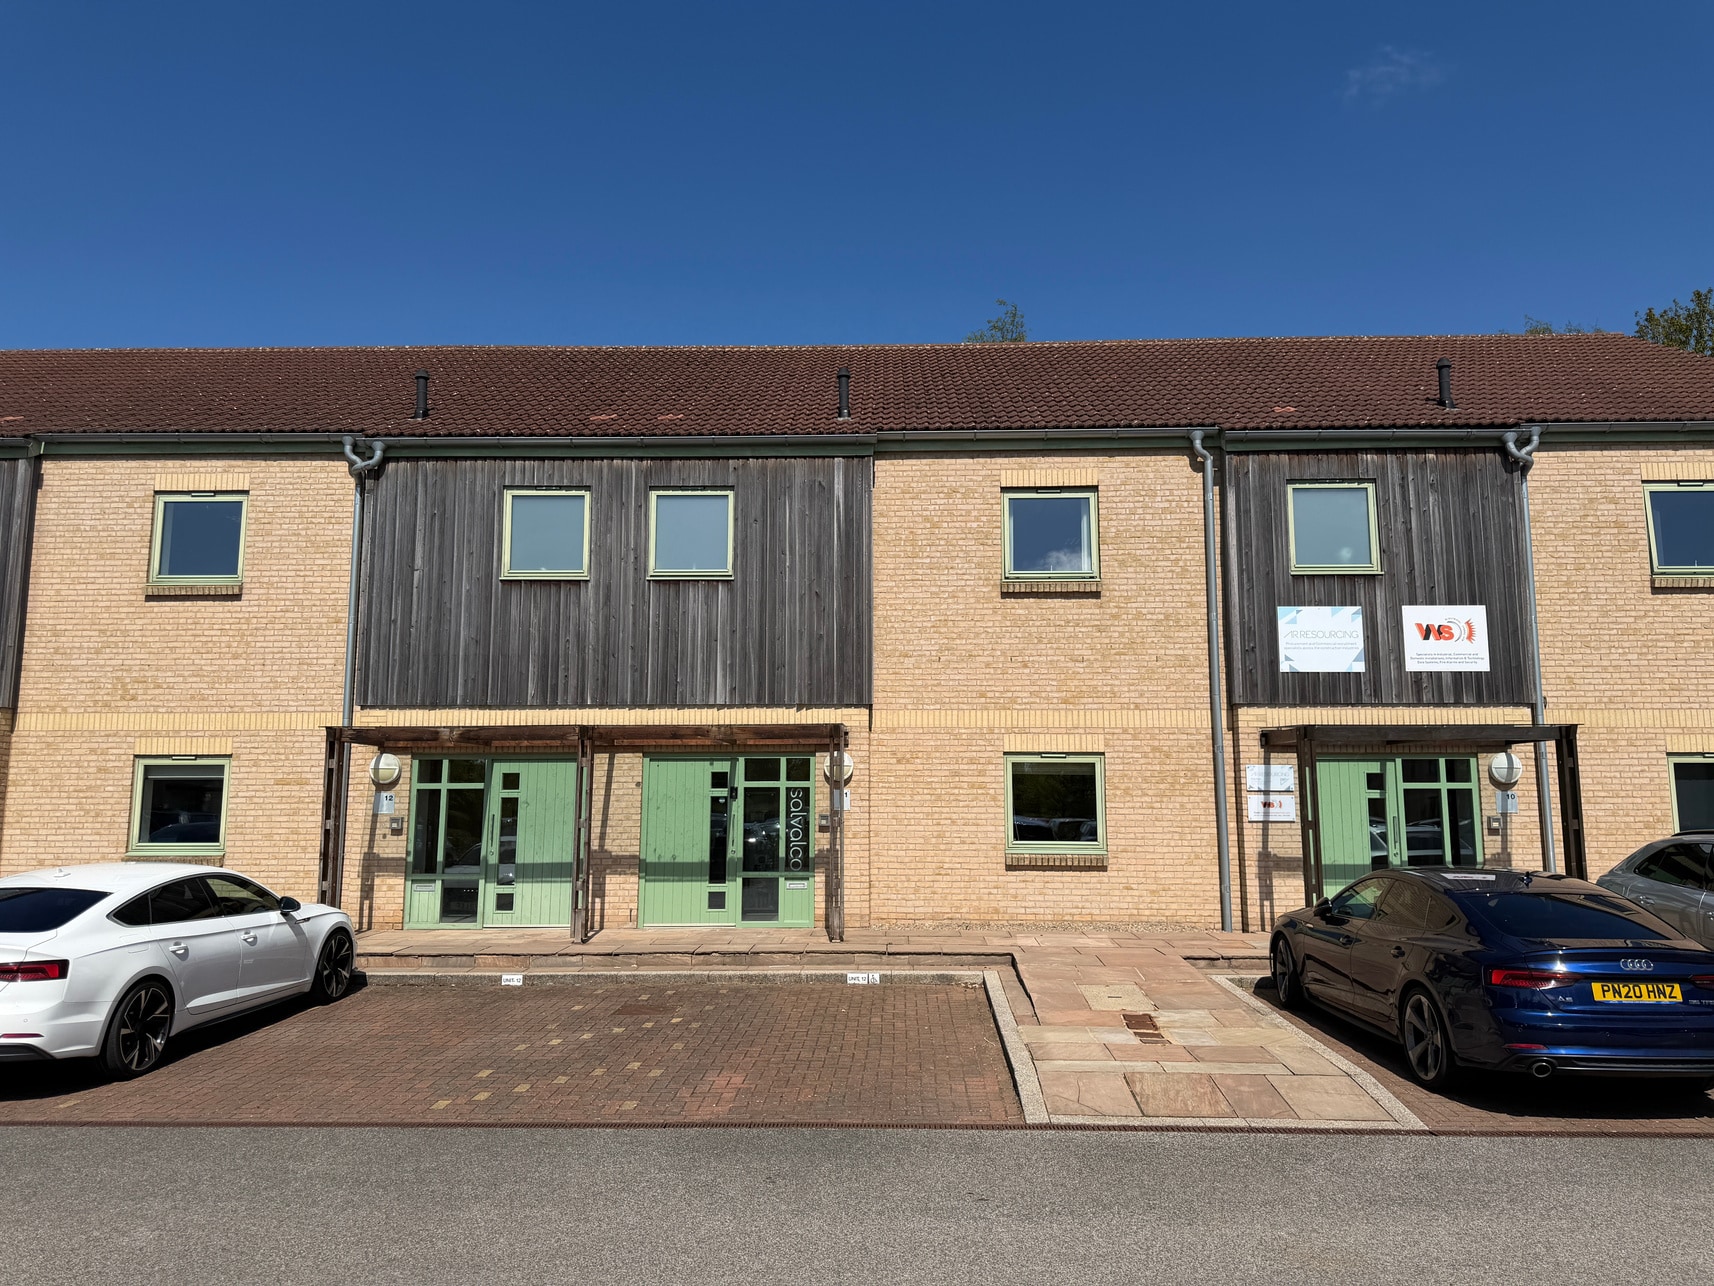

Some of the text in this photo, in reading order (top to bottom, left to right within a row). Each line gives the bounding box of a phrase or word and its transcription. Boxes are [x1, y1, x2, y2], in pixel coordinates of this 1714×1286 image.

[1300, 630, 1359, 638] RESOURCING
[790, 788, 807, 871] salvalco
[1601, 984, 1678, 999] PN20 HNZ
